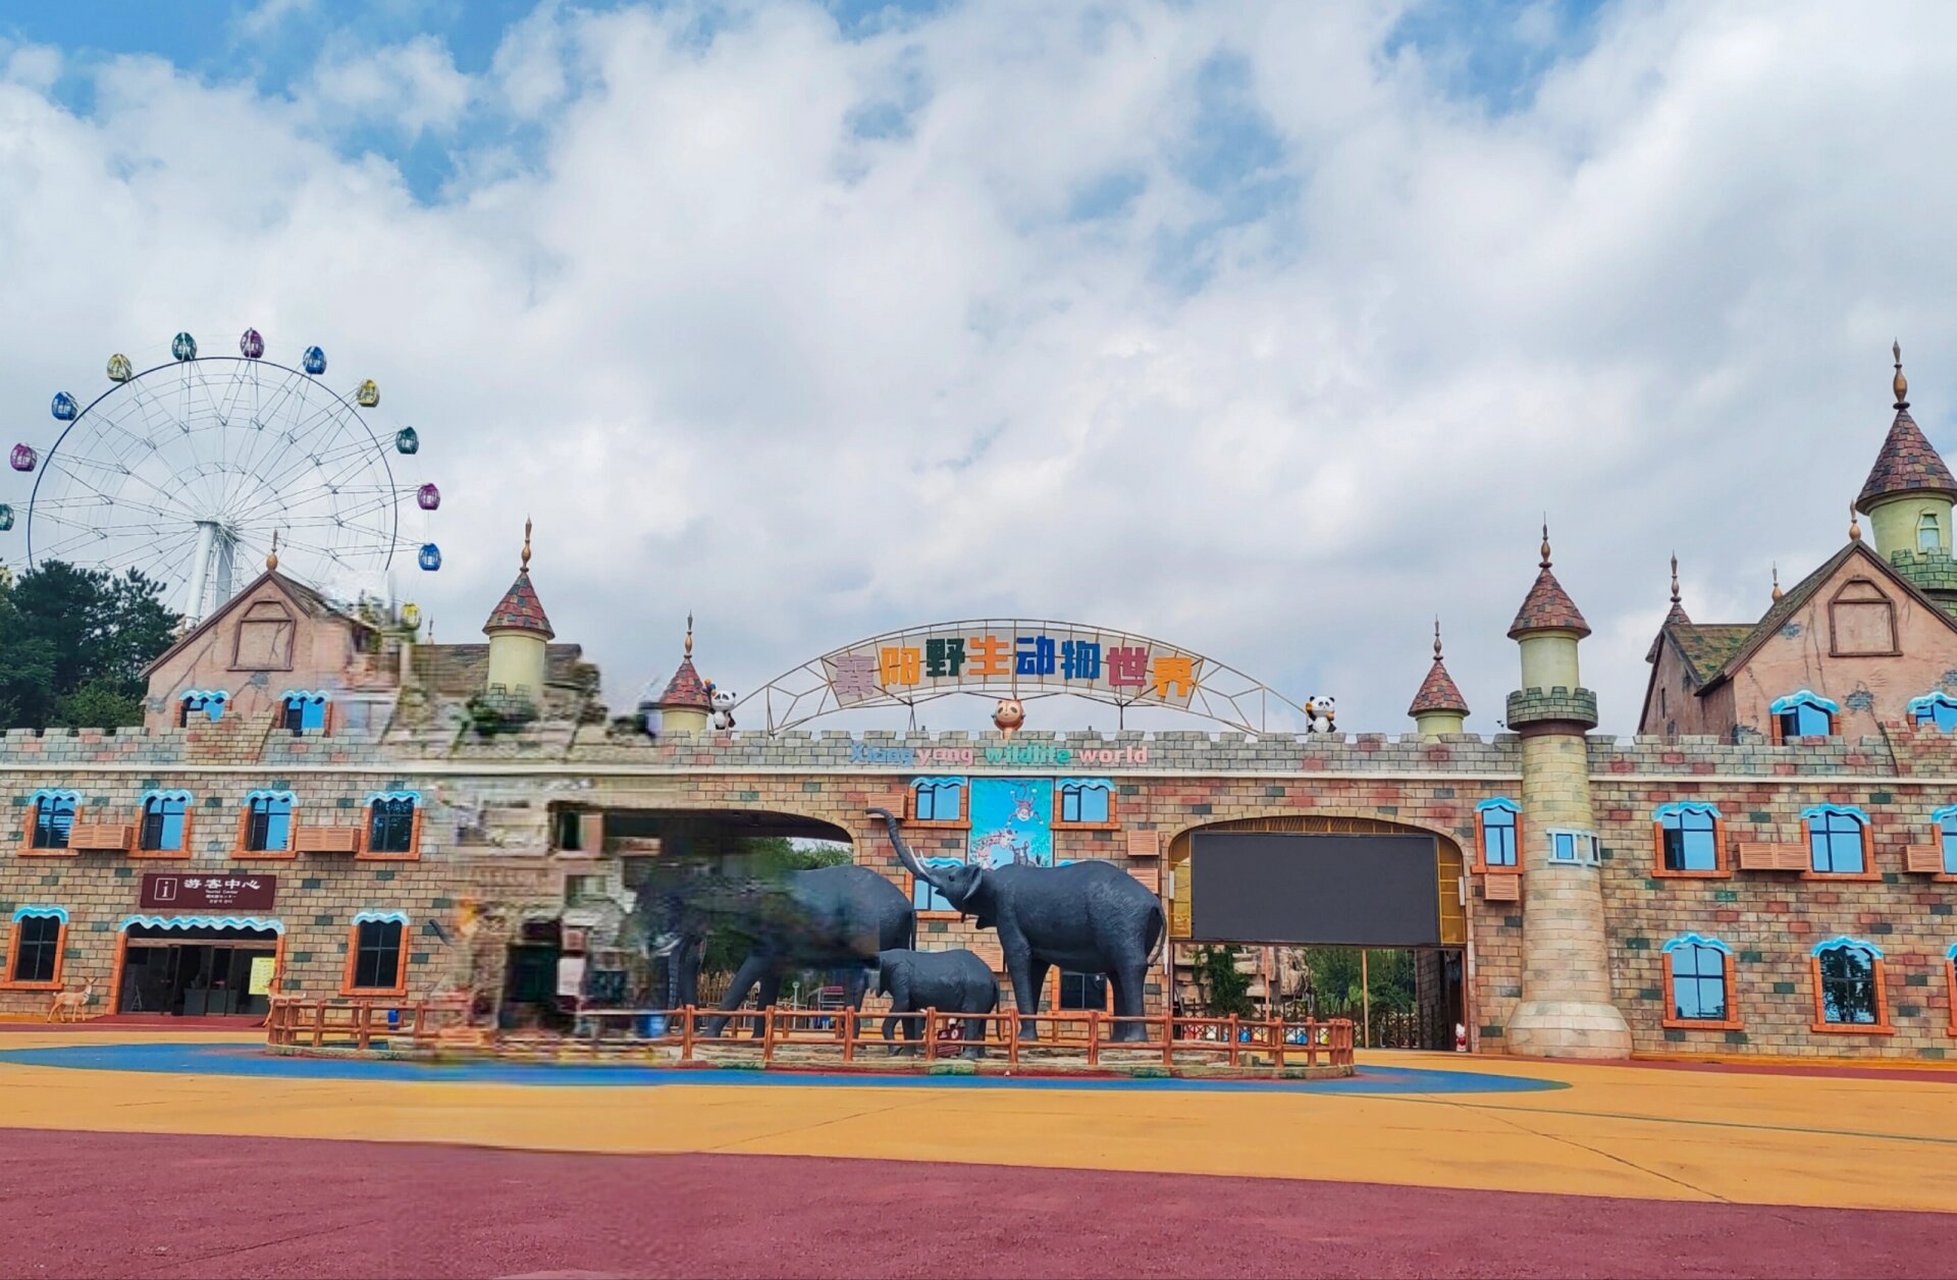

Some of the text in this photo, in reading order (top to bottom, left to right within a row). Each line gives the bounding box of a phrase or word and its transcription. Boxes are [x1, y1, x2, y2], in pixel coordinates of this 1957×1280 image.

[836, 635, 1193, 698] 襄阳野生动物世界
[985, 742, 1071, 765] wildlife
[1079, 746, 1148, 764] world
[184, 878, 261, 890] 游客中心
